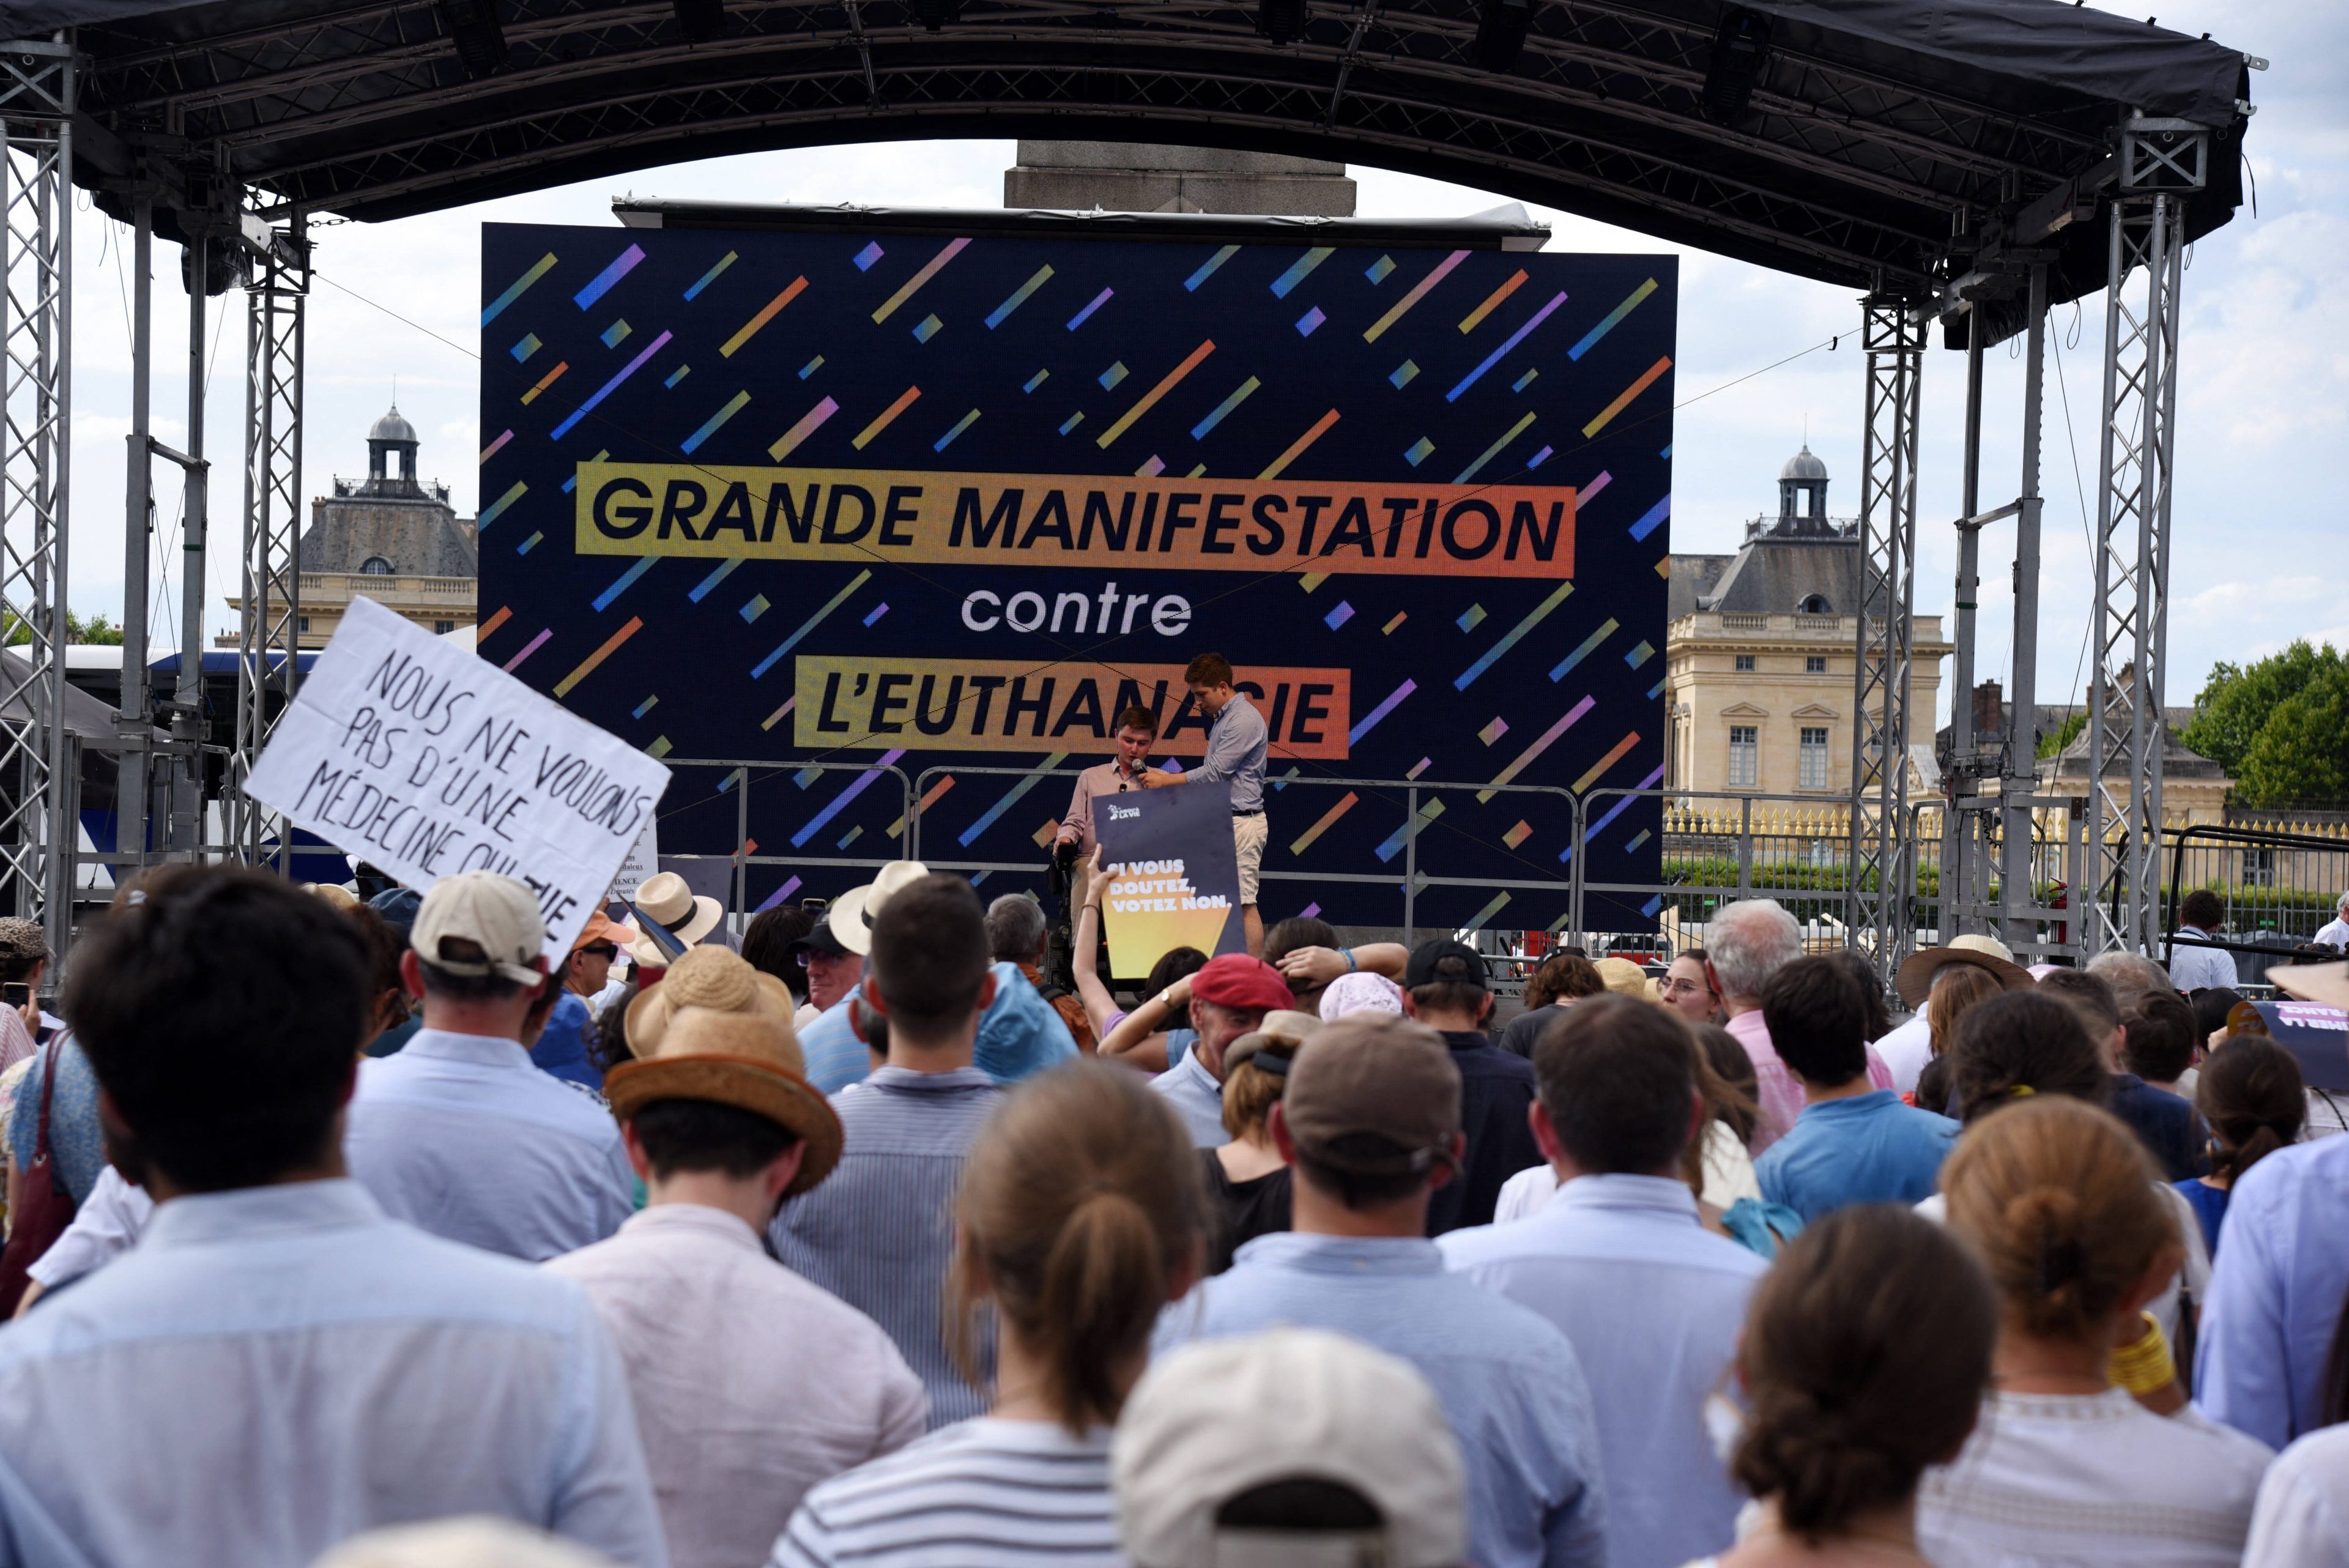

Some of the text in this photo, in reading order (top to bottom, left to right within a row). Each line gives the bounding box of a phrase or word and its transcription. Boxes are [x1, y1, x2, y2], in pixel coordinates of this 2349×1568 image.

[592, 477, 1565, 562] GRANDE MANIFESTATION
[961, 582, 1192, 636] contre
[366, 648, 475, 736] NOUS
[464, 717, 530, 774] NE
[341, 707, 529, 842] PAS D'UNE
[294, 759, 466, 877] MÉDECINE
[1109, 878, 1196, 895] DOUTEZ,
[1129, 859, 1184, 876] VOUS
[1112, 895, 1232, 912] VOTEZ NON.
